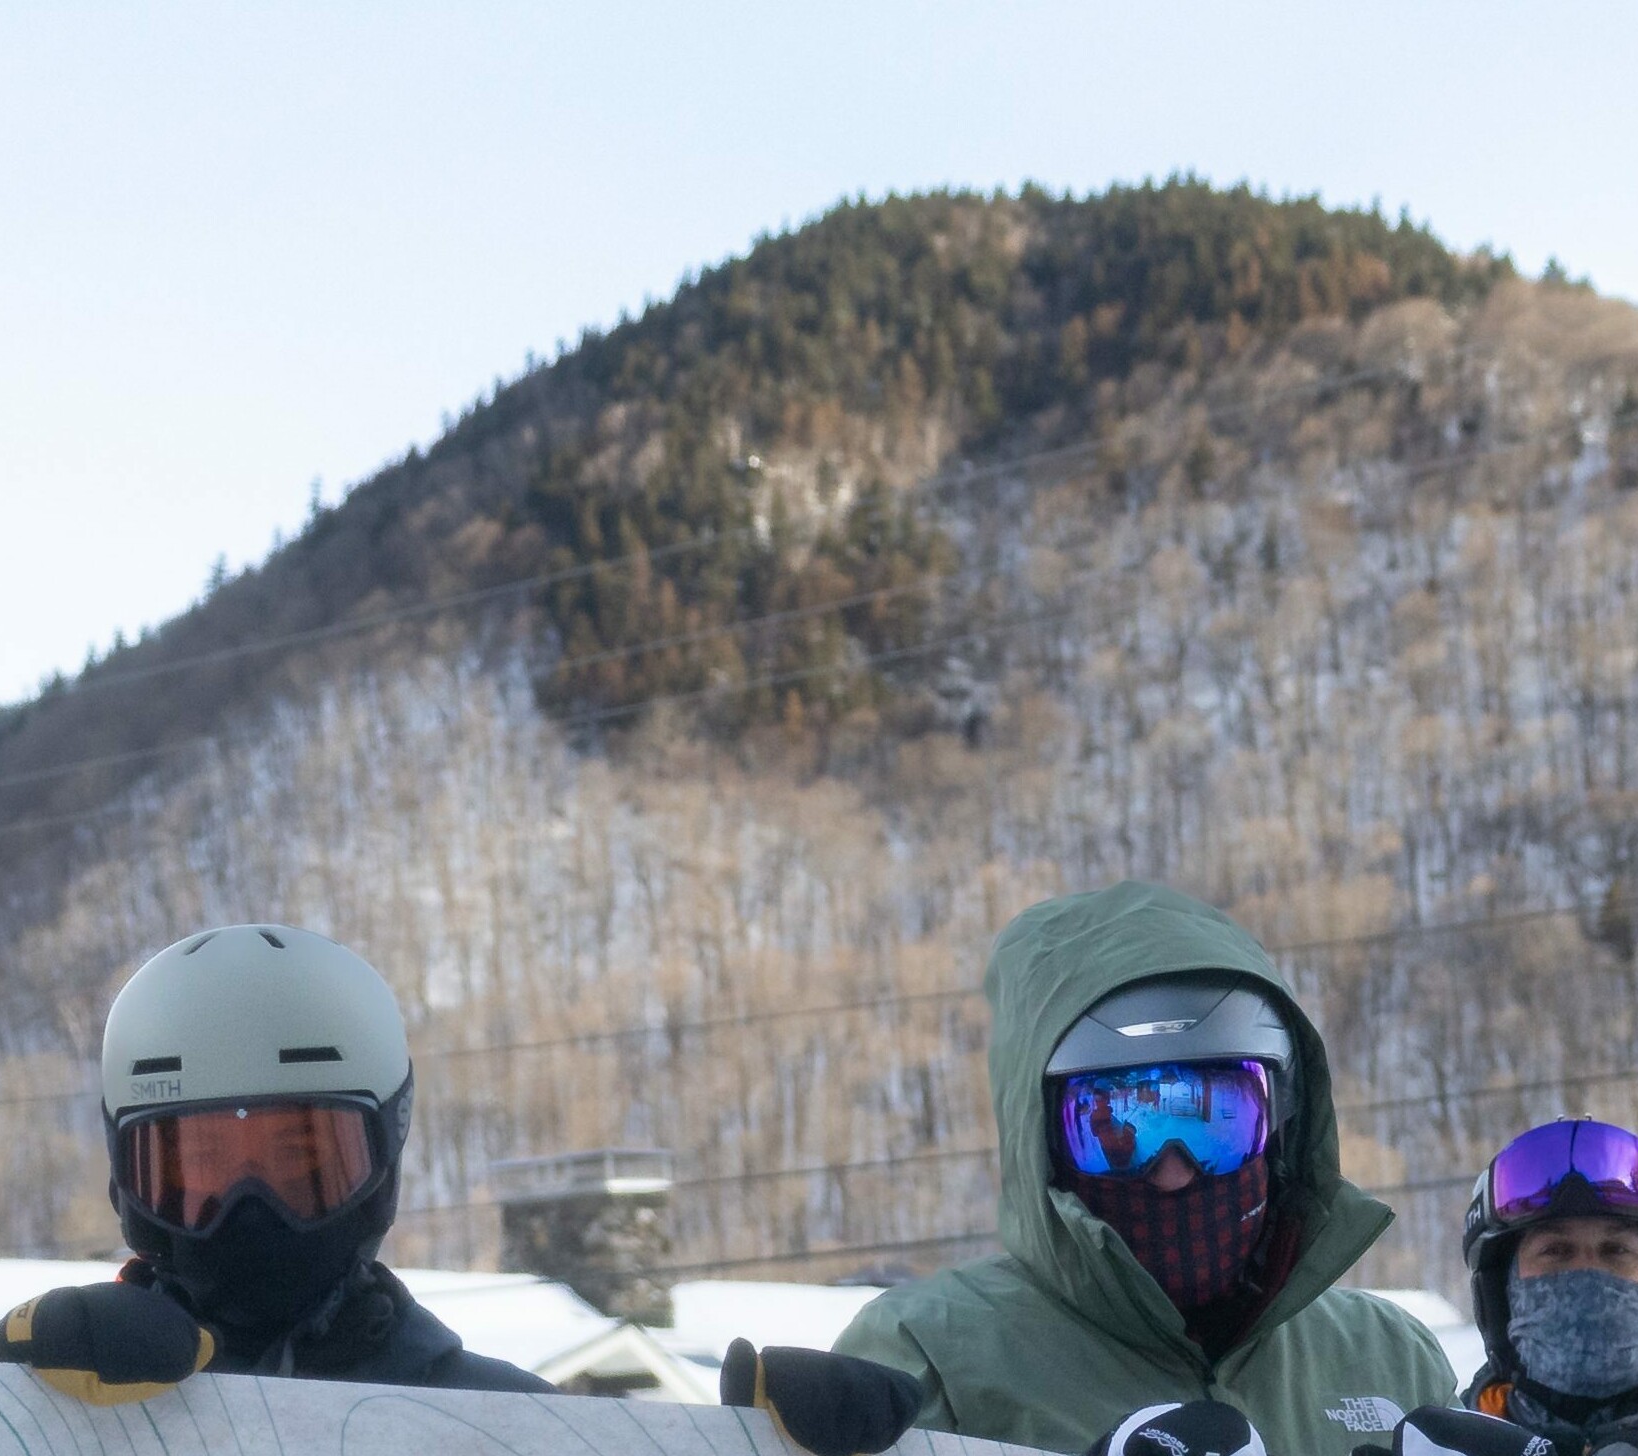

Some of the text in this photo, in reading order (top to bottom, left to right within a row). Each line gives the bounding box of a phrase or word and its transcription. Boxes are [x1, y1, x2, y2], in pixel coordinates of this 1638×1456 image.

[131, 1079, 182, 1100] SMITH
[1340, 1396, 1374, 1410] THE
[1325, 1407, 1380, 1421] NORTH
[1344, 1420, 1384, 1432] FACE
